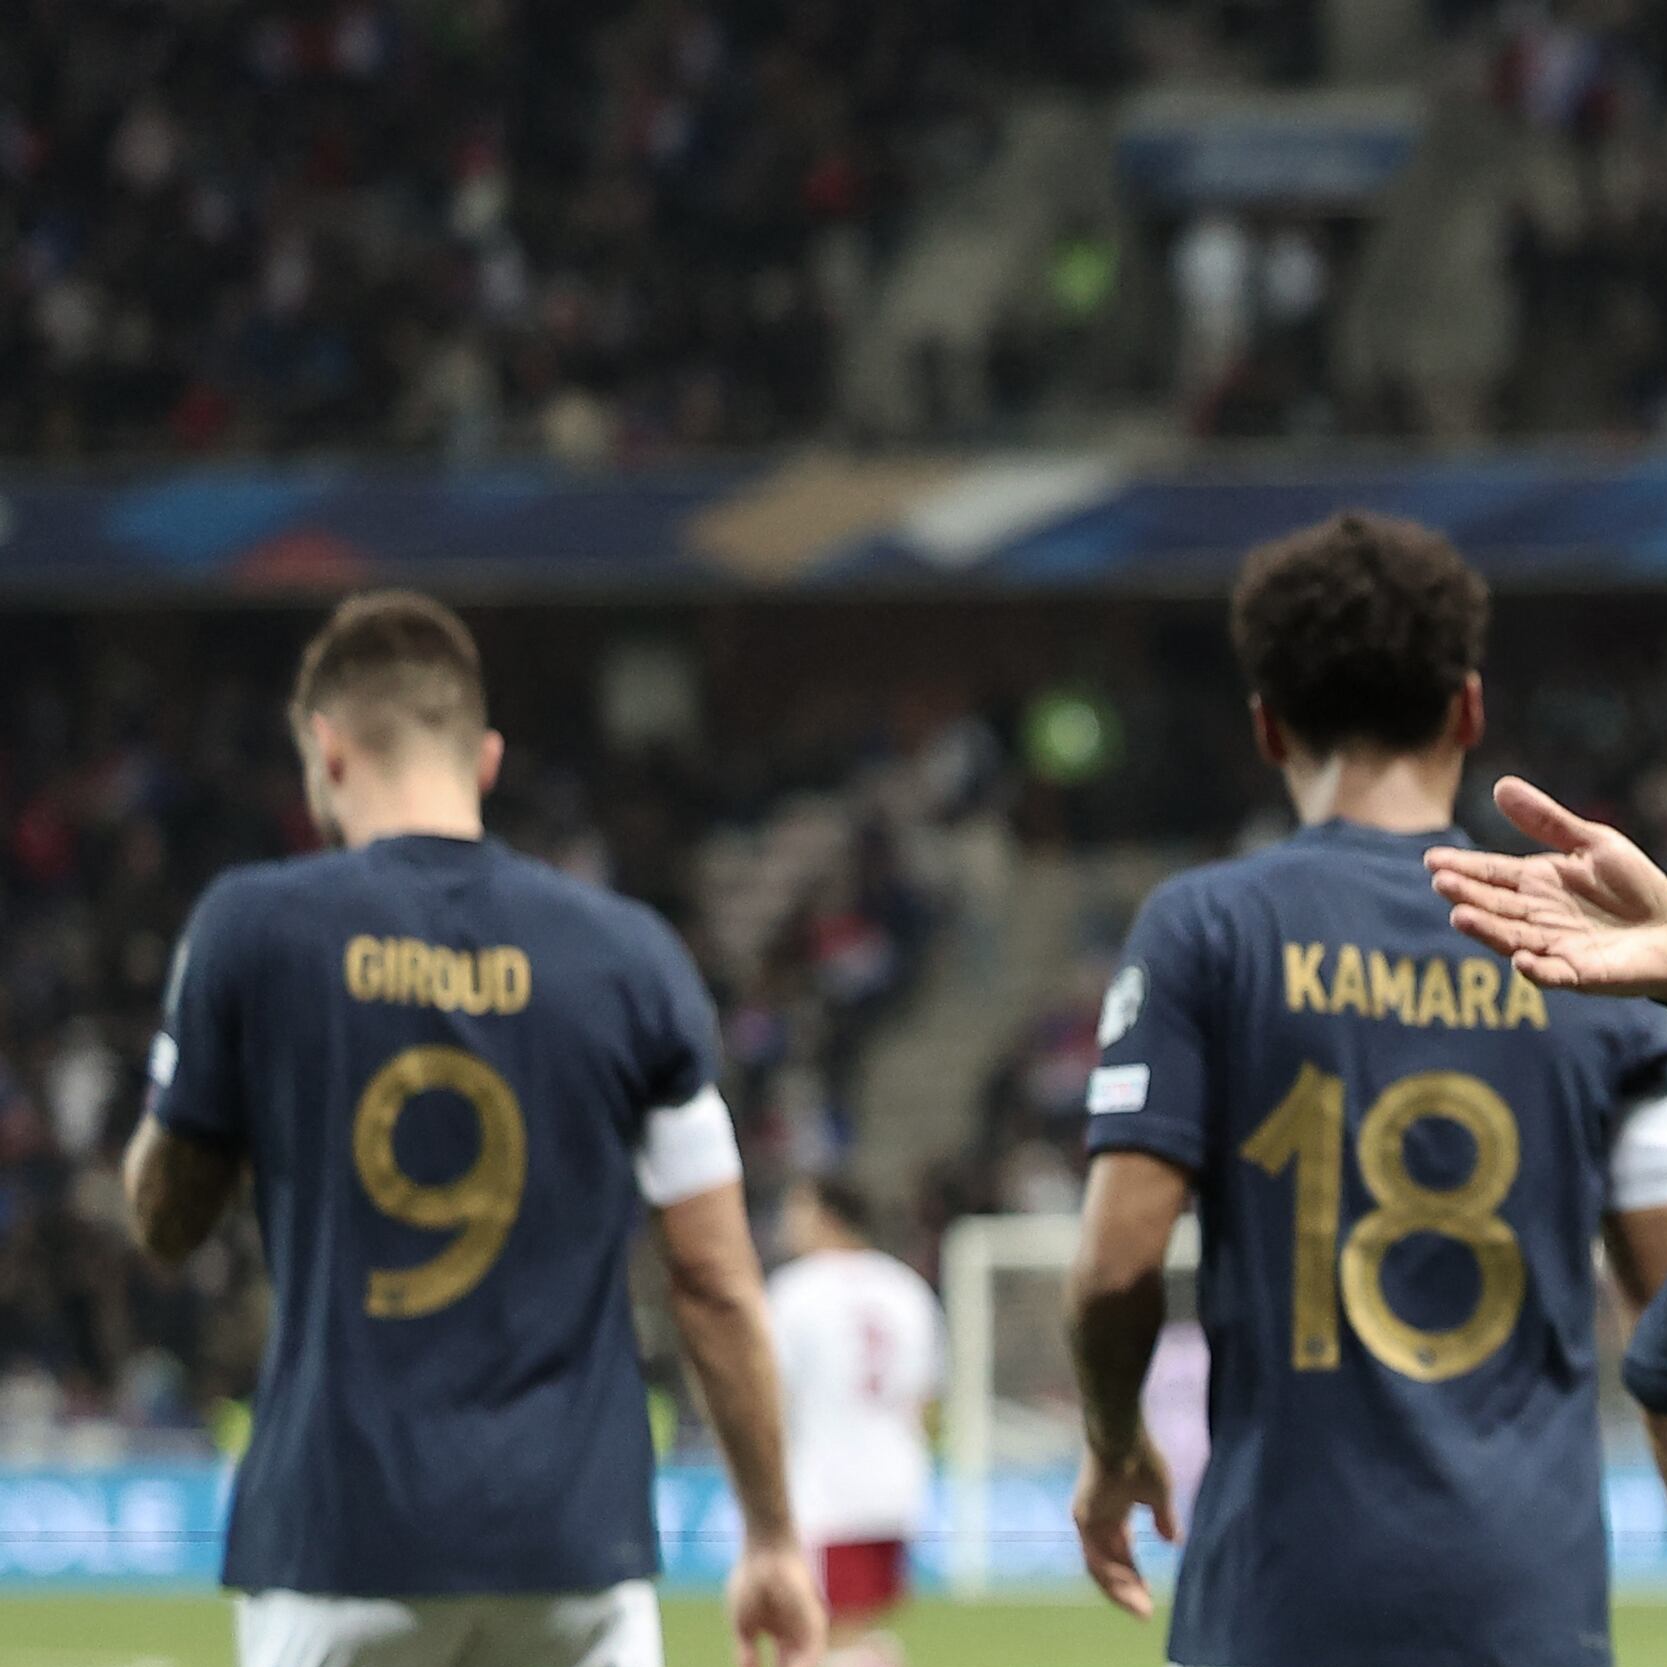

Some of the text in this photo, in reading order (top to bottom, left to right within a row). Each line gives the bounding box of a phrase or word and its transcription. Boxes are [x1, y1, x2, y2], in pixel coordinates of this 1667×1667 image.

[346, 935, 533, 1015] GIROUD
[1283, 943, 1549, 1030] KAMARA
[352, 1044, 528, 1320] 9
[1239, 1062, 1526, 1383] 18
